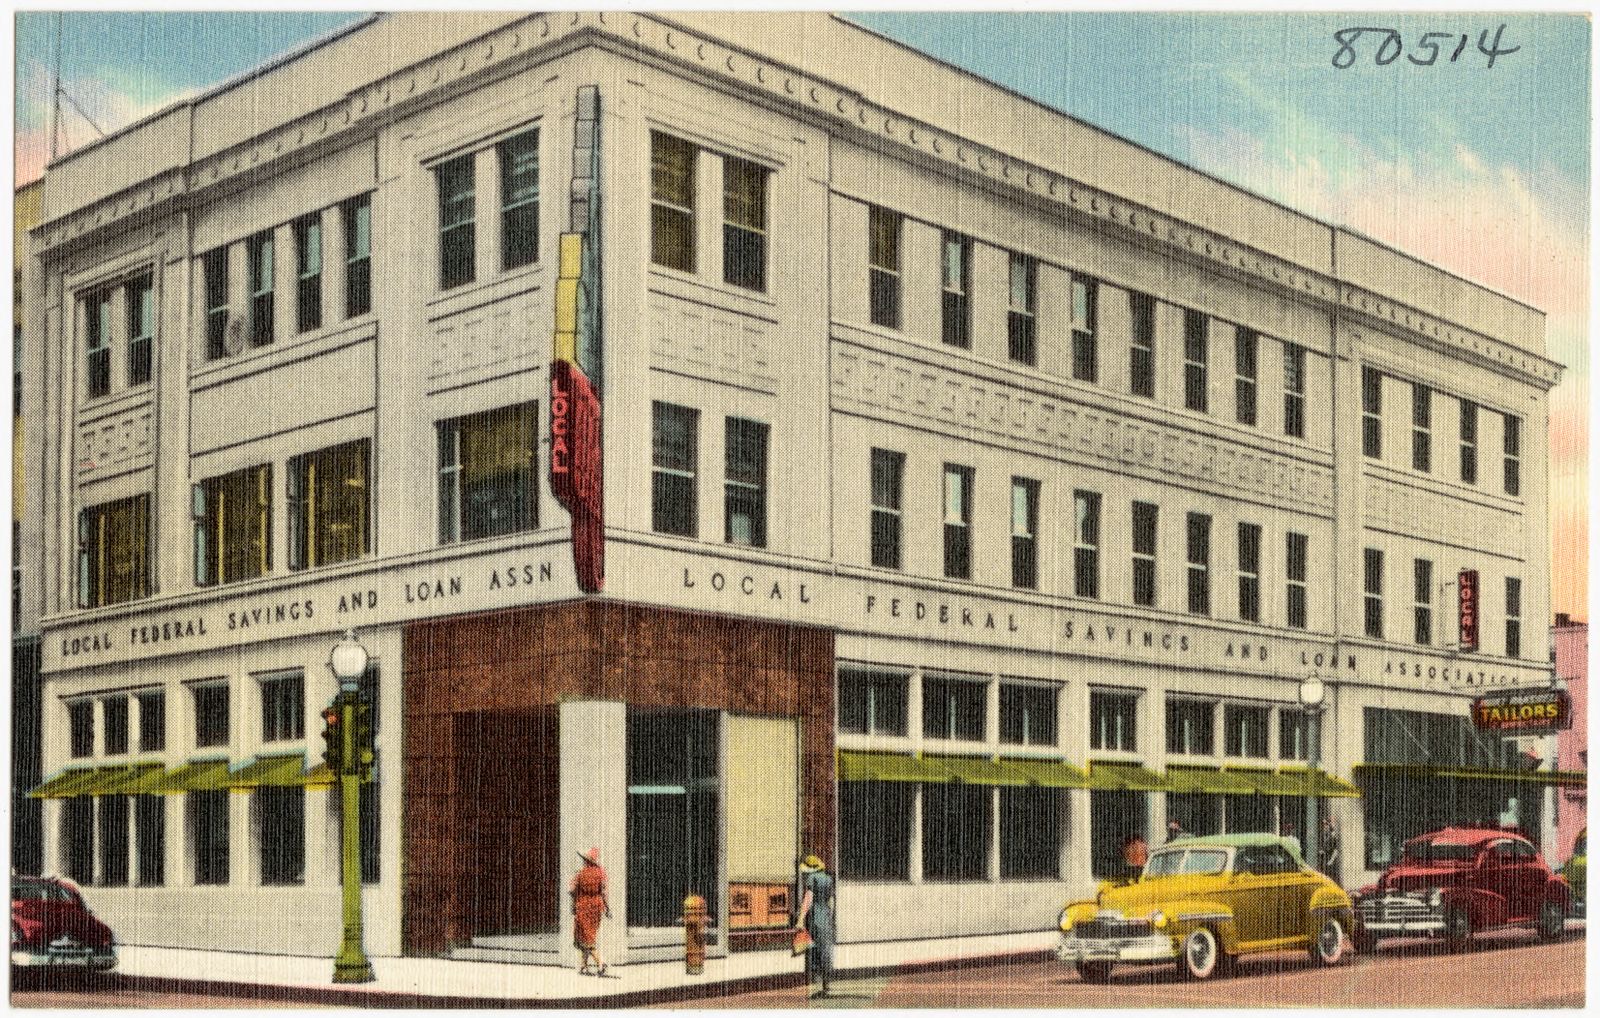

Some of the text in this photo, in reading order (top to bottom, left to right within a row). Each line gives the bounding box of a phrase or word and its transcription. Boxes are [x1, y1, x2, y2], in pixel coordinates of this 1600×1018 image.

[1332, 24, 1521, 69] 80514
[551, 379, 569, 474] LOCAL
[62, 562, 553, 656] LOCAL FEDERAL SAVINGS AND LOAN ASSN
[684, 568, 810, 603] LOCAL
[867, 596, 1018, 632] FEDERAL
[1065, 621, 1190, 651] SAVINGS
[1224, 644, 1268, 661] AND
[1301, 651, 1357, 671] LOAN
[1460, 574, 1475, 644] LOCAL
[1481, 703, 1559, 721] TAILORS
